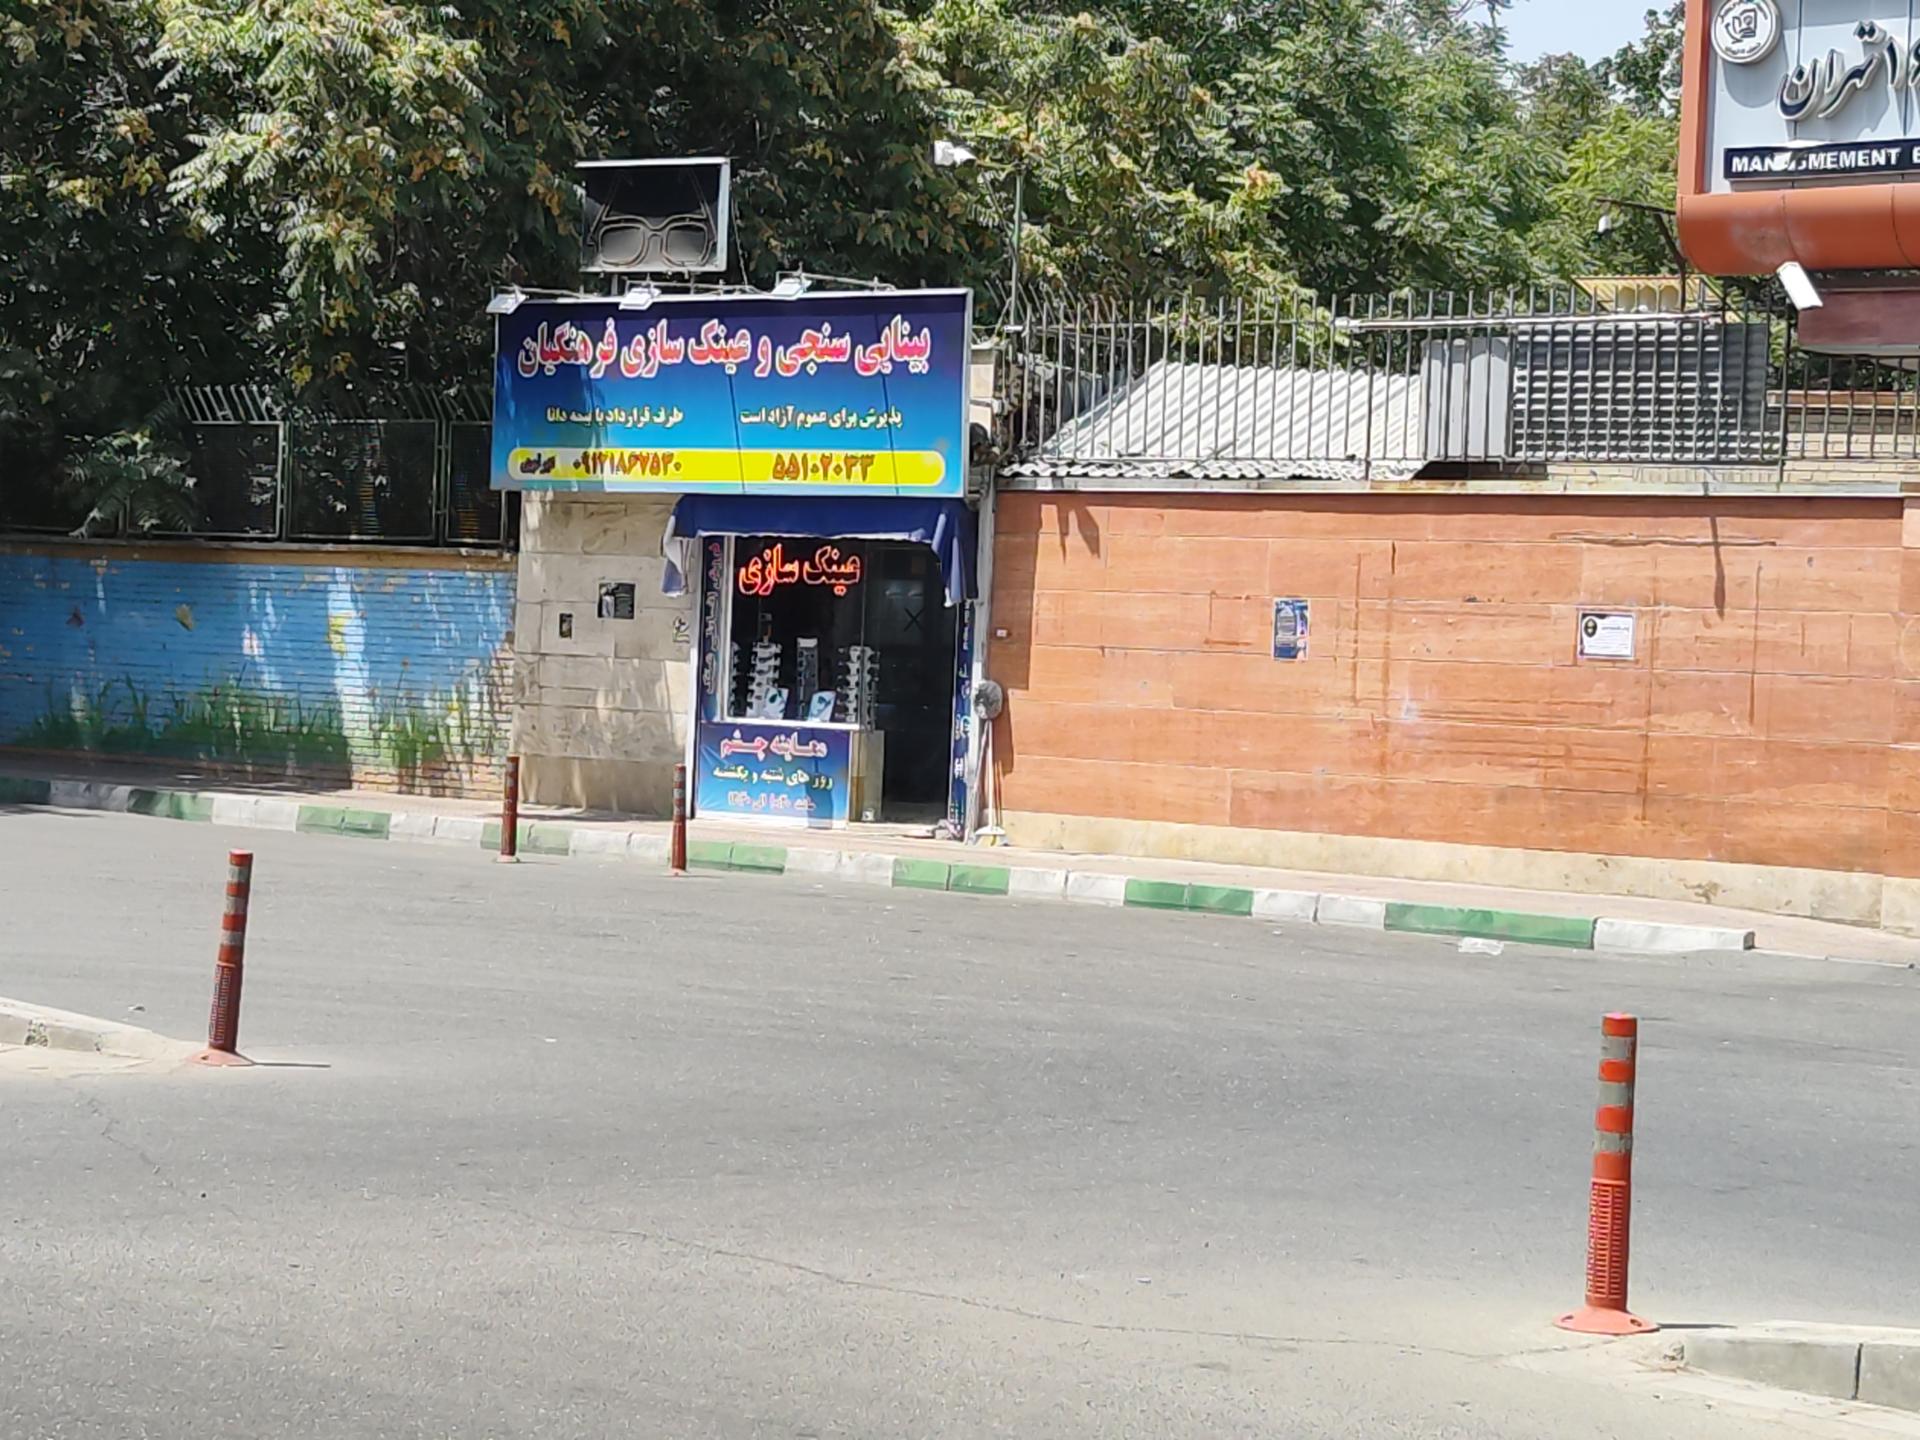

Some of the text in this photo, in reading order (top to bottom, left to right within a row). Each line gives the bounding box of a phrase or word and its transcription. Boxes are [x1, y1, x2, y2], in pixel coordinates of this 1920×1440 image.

[517, 314, 931, 378] بینایی سنجی و عینک سازی فرهنگیان
[605, 405, 651, 428] قرارداد
[652, 406, 684, 428] طرف
[740, 404, 904, 431] پذیرش برای عموم آزاد است
[739, 543, 861, 597] عینک سازی
[720, 729, 828, 762] معاینه چشم
[785, 768, 811, 786] های
